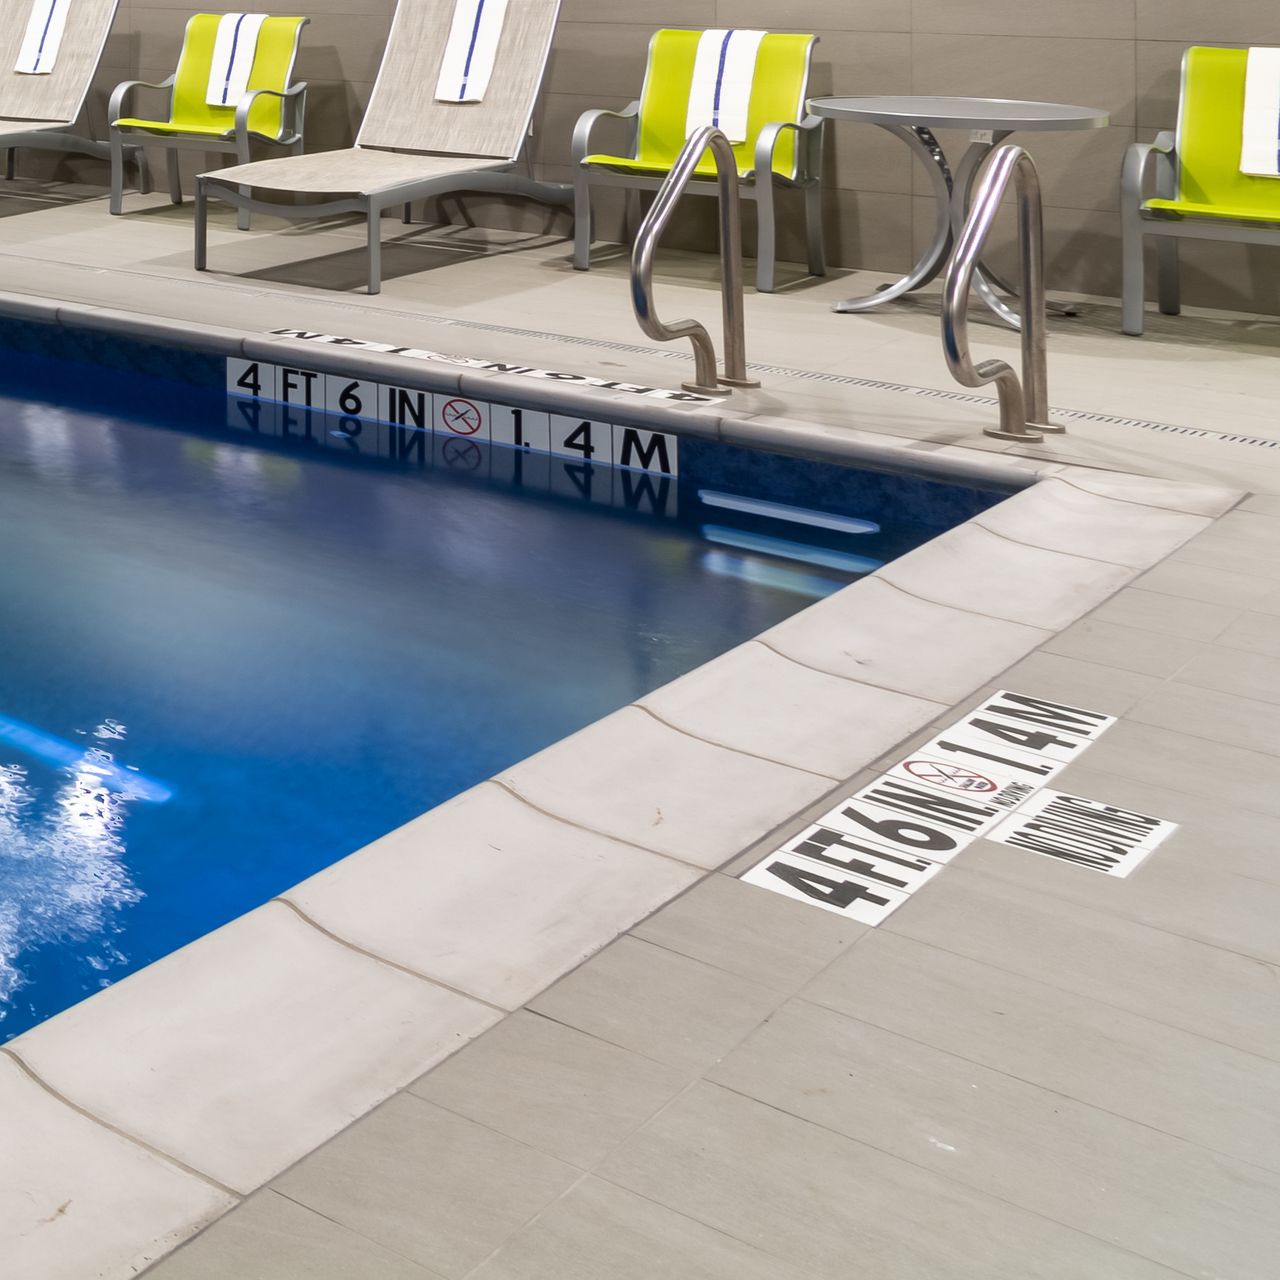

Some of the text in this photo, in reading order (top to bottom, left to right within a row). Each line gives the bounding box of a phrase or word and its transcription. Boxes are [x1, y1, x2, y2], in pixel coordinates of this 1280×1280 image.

[237, 363, 261, 396] 4
[282, 370, 317, 407] FT
[340, 381, 362, 416] 6
[389, 387, 425, 428] IN
[765, 860, 891, 909] 4
[840, 806, 958, 851] 6
[1004, 795, 1162, 873] NO DIVING
